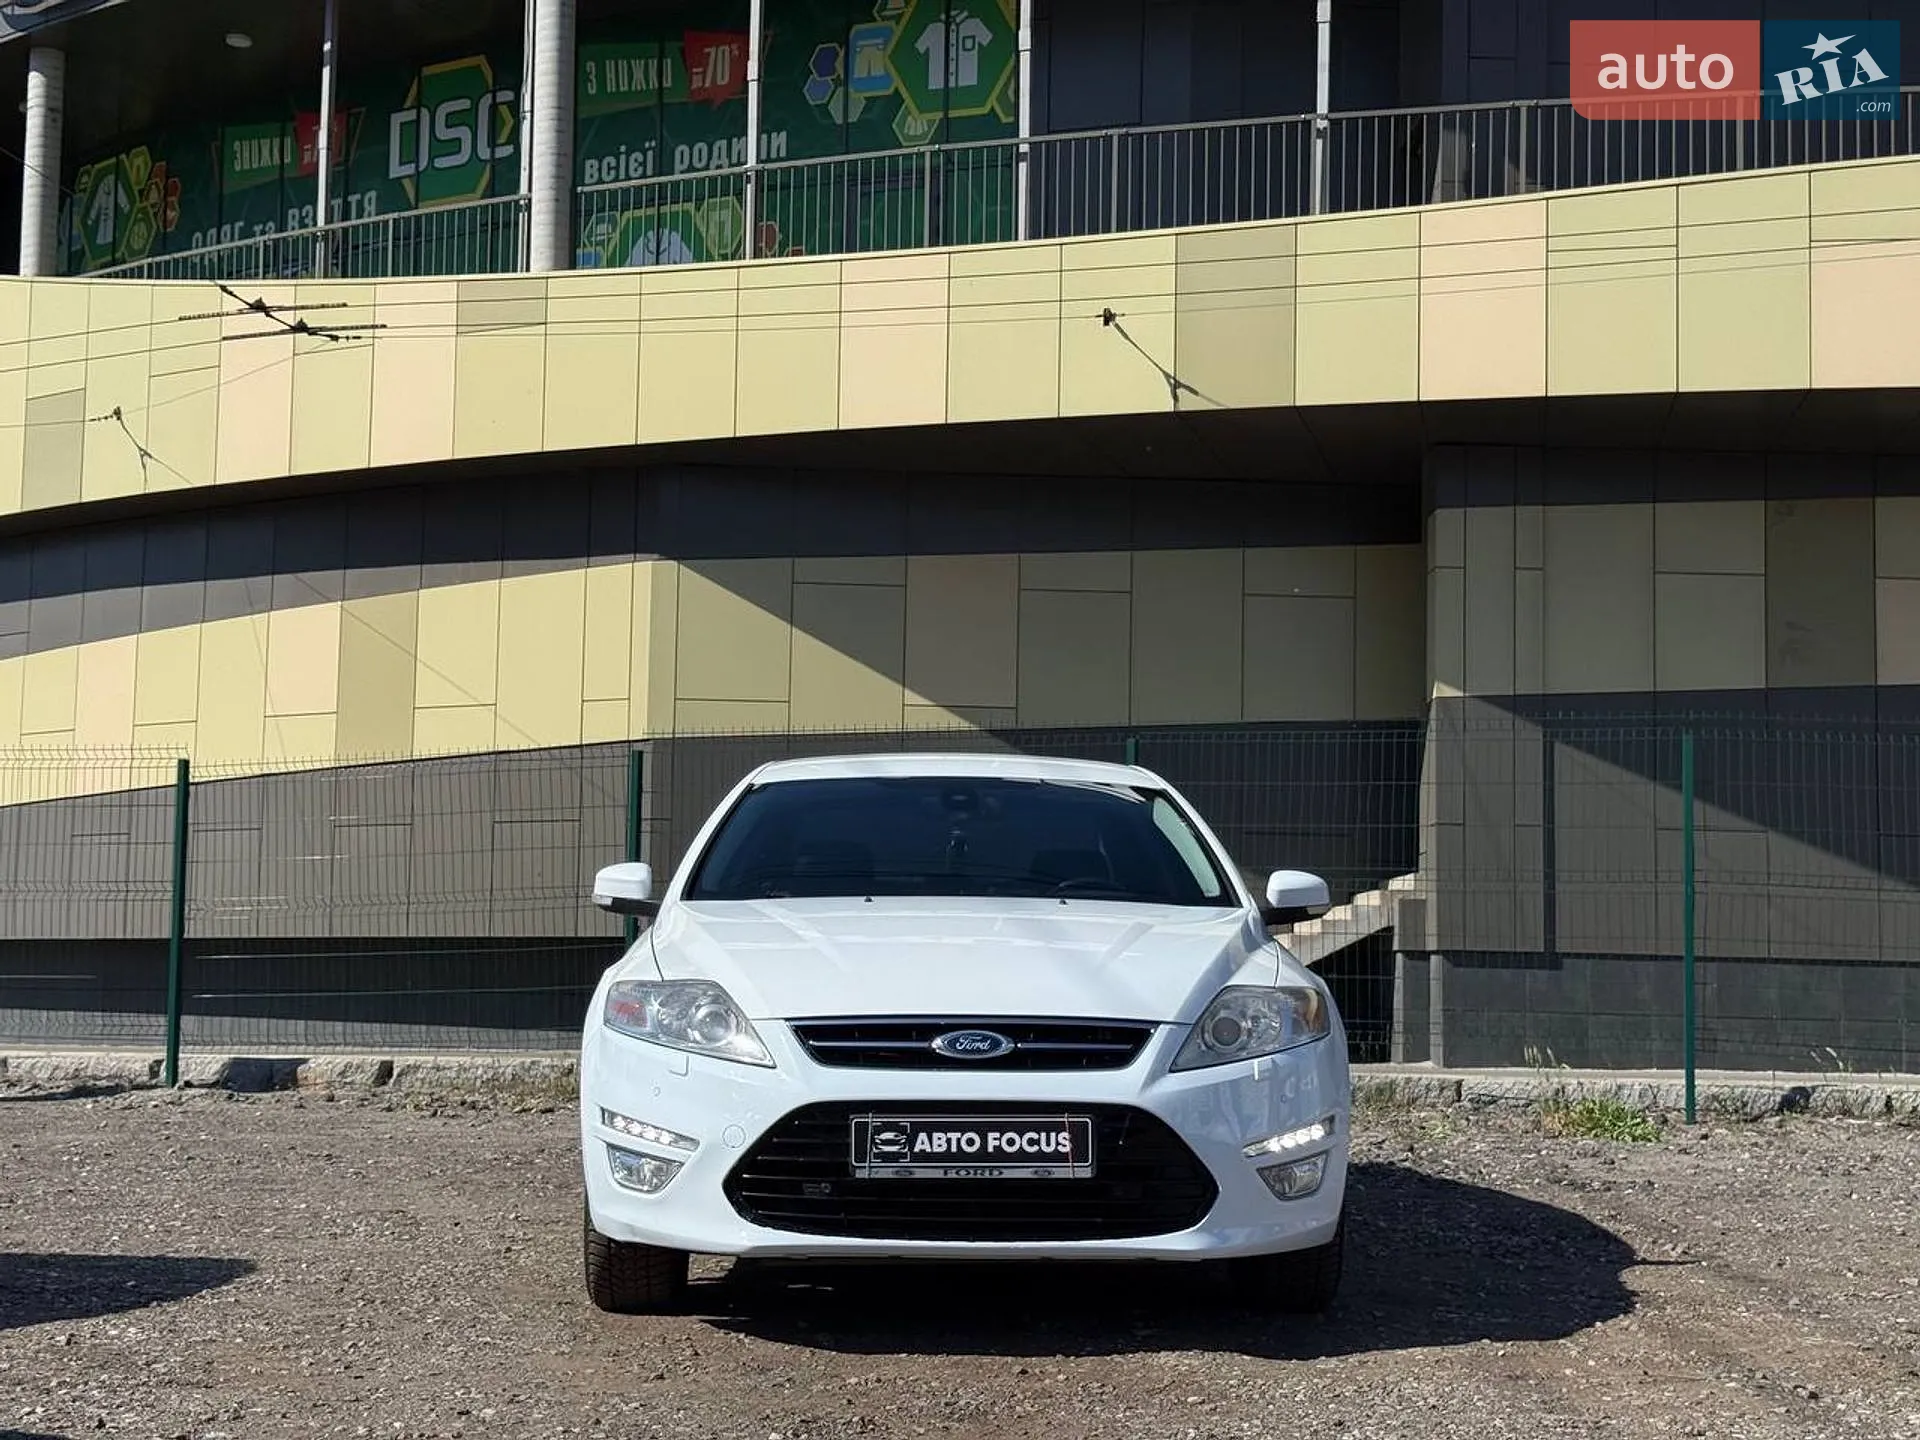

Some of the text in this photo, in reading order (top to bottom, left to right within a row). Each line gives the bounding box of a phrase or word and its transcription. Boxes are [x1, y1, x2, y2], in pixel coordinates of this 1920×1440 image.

[388, 89, 516, 180] DSC
[584, 138, 656, 184] всієї
[955, 1035, 991, 1050] Ford
[986, 1132, 1072, 1153] FOCUS
[943, 1168, 1005, 1177] FORD
